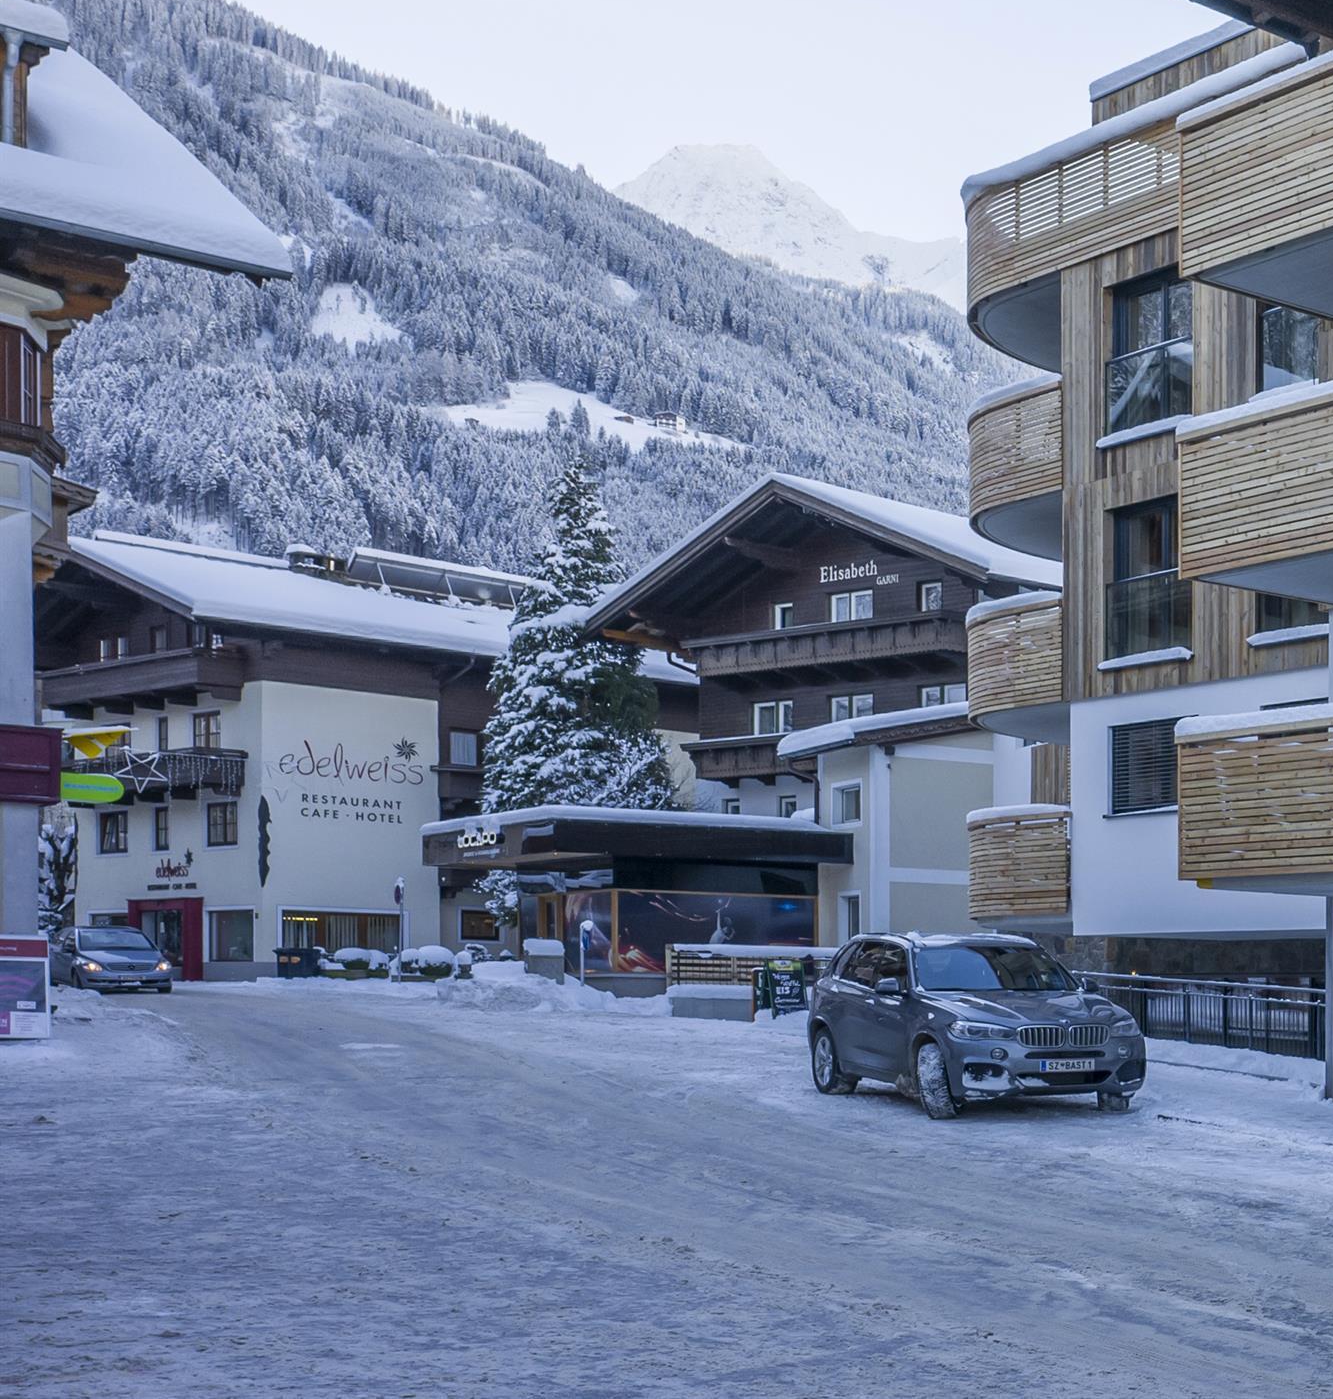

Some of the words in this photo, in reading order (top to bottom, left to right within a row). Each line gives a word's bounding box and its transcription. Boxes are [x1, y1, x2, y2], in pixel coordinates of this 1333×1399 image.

[820, 560, 877, 583] Elisabeth
[876, 574, 899, 585] GARNI
[279, 740, 424, 786] edelweiss
[302, 794, 402, 810] RESTAURANT
[301, 808, 339, 819] CAFE
[356, 812, 403, 824] HOTEL
